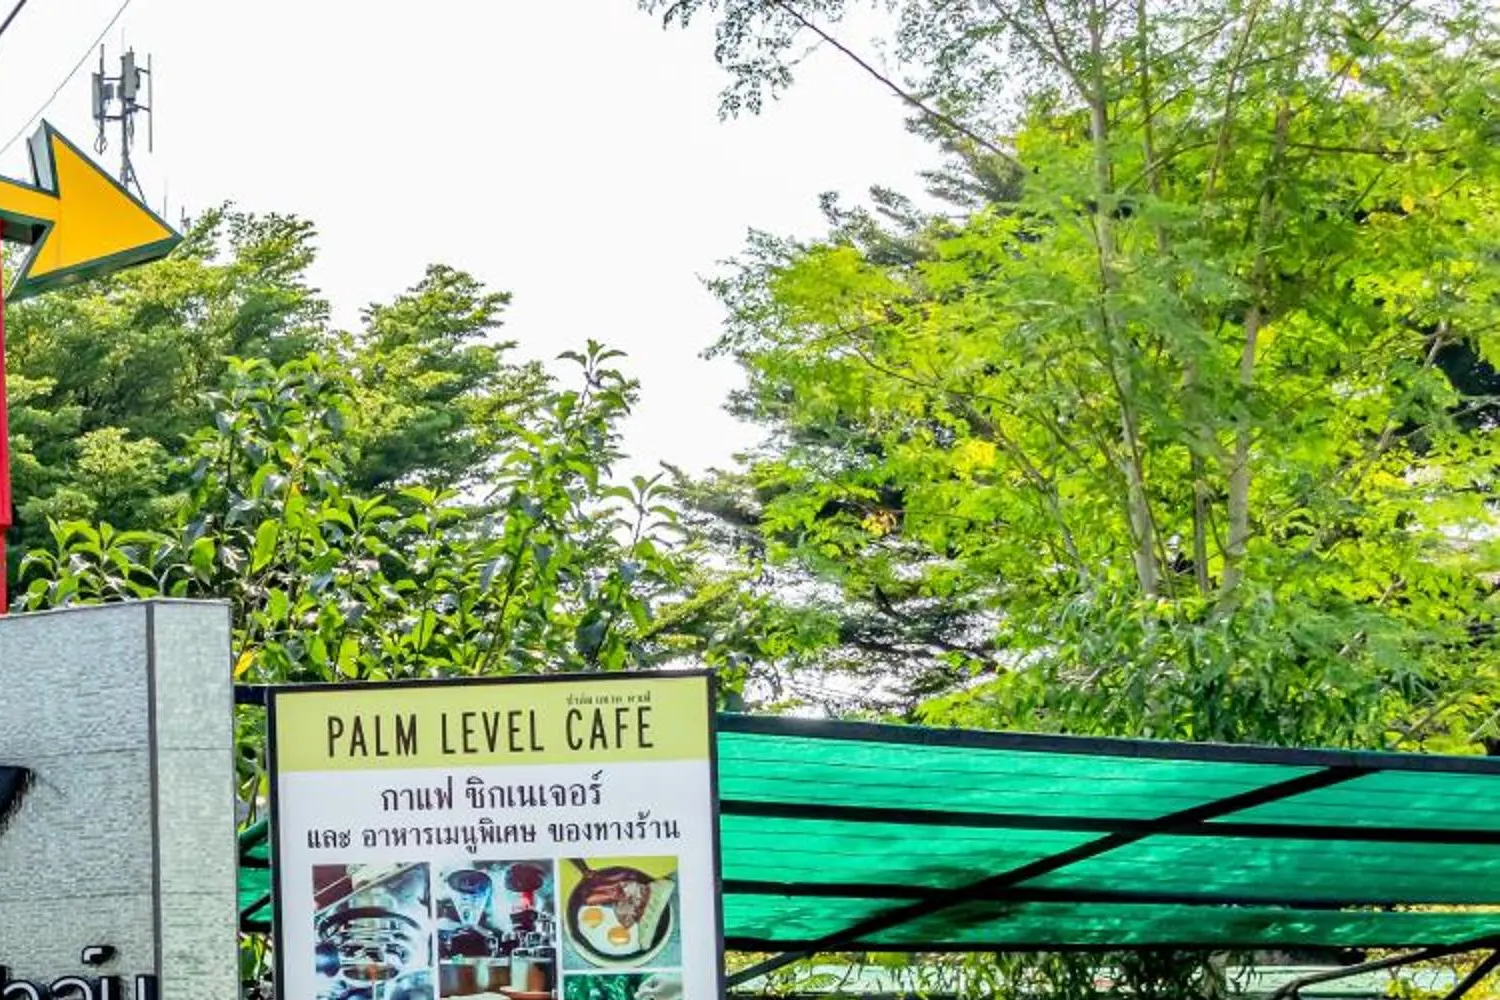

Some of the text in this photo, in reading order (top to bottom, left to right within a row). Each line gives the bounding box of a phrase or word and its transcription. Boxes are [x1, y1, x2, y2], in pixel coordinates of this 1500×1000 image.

[327, 706, 653, 757] PALM LEVEL CAFE
[381, 776, 454, 812] กาแฟ
[307, 811, 680, 854] และ อาหารเมนูพิเศษ ของทางร้าน
